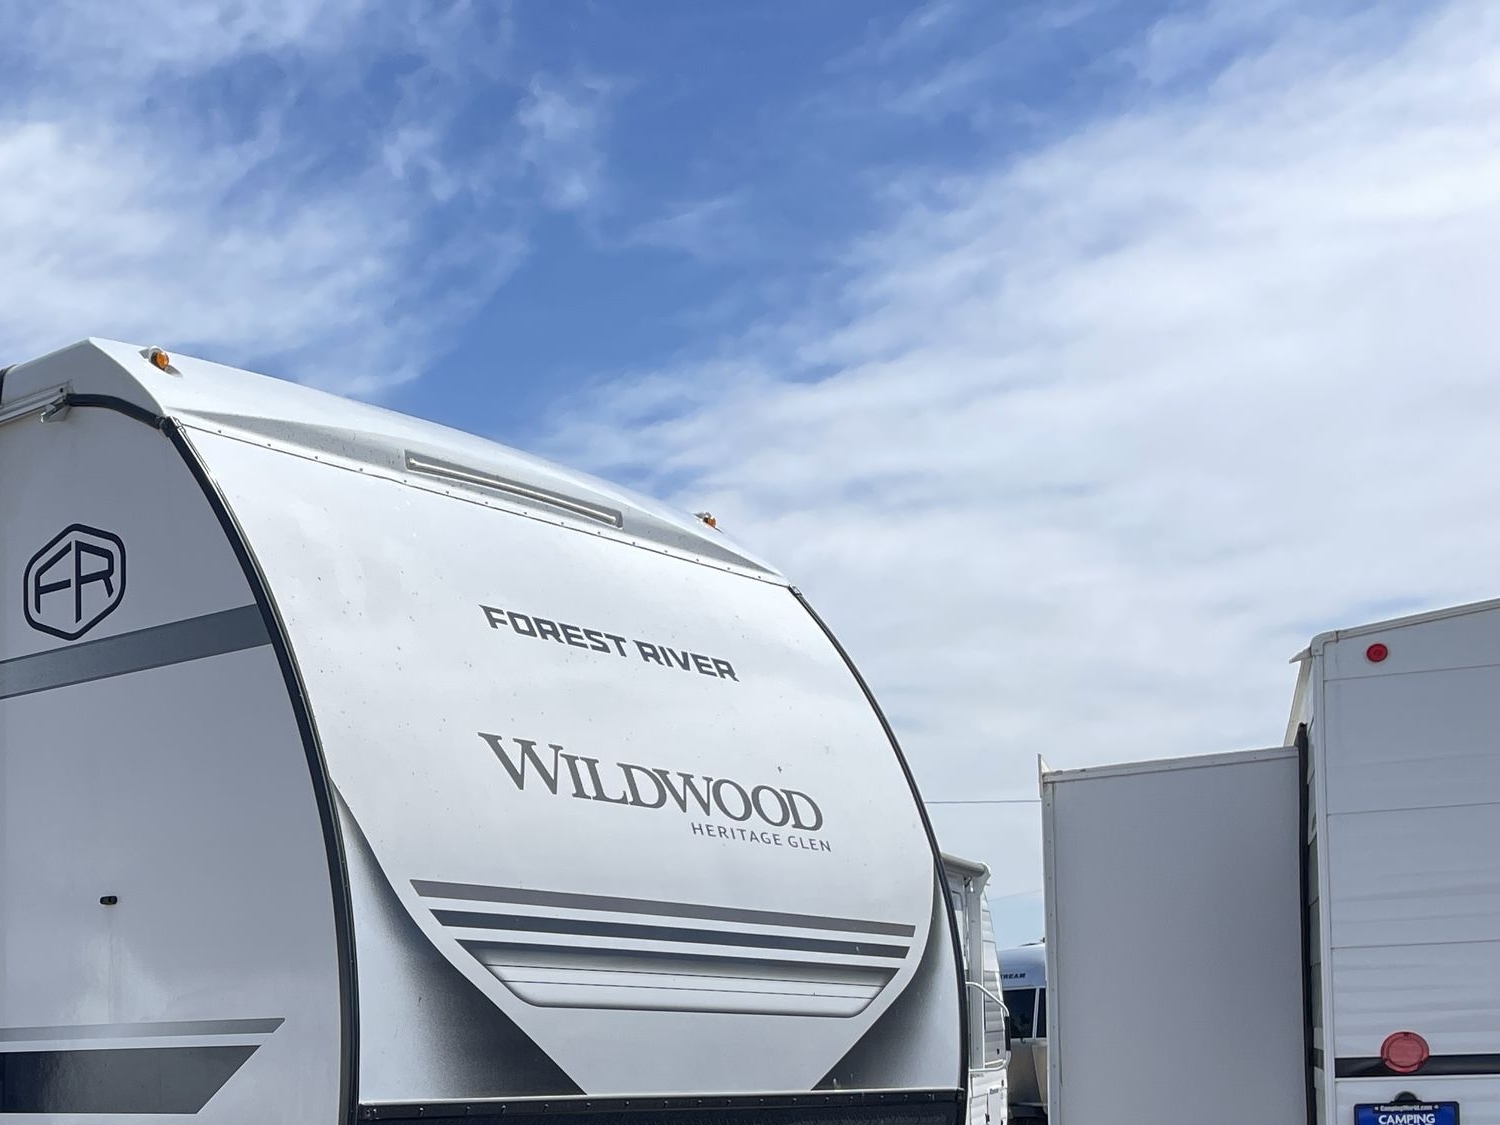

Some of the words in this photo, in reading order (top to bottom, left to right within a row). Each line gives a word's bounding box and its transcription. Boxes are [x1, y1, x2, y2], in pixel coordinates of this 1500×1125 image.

[478, 604, 627, 658] FOREST
[632, 639, 740, 682] RIVER
[477, 732, 824, 832] WILDWOOD
[690, 821, 783, 848] HERITAGE
[787, 835, 832, 853] GLEN
[1378, 1114, 1436, 1125] CAMPING
